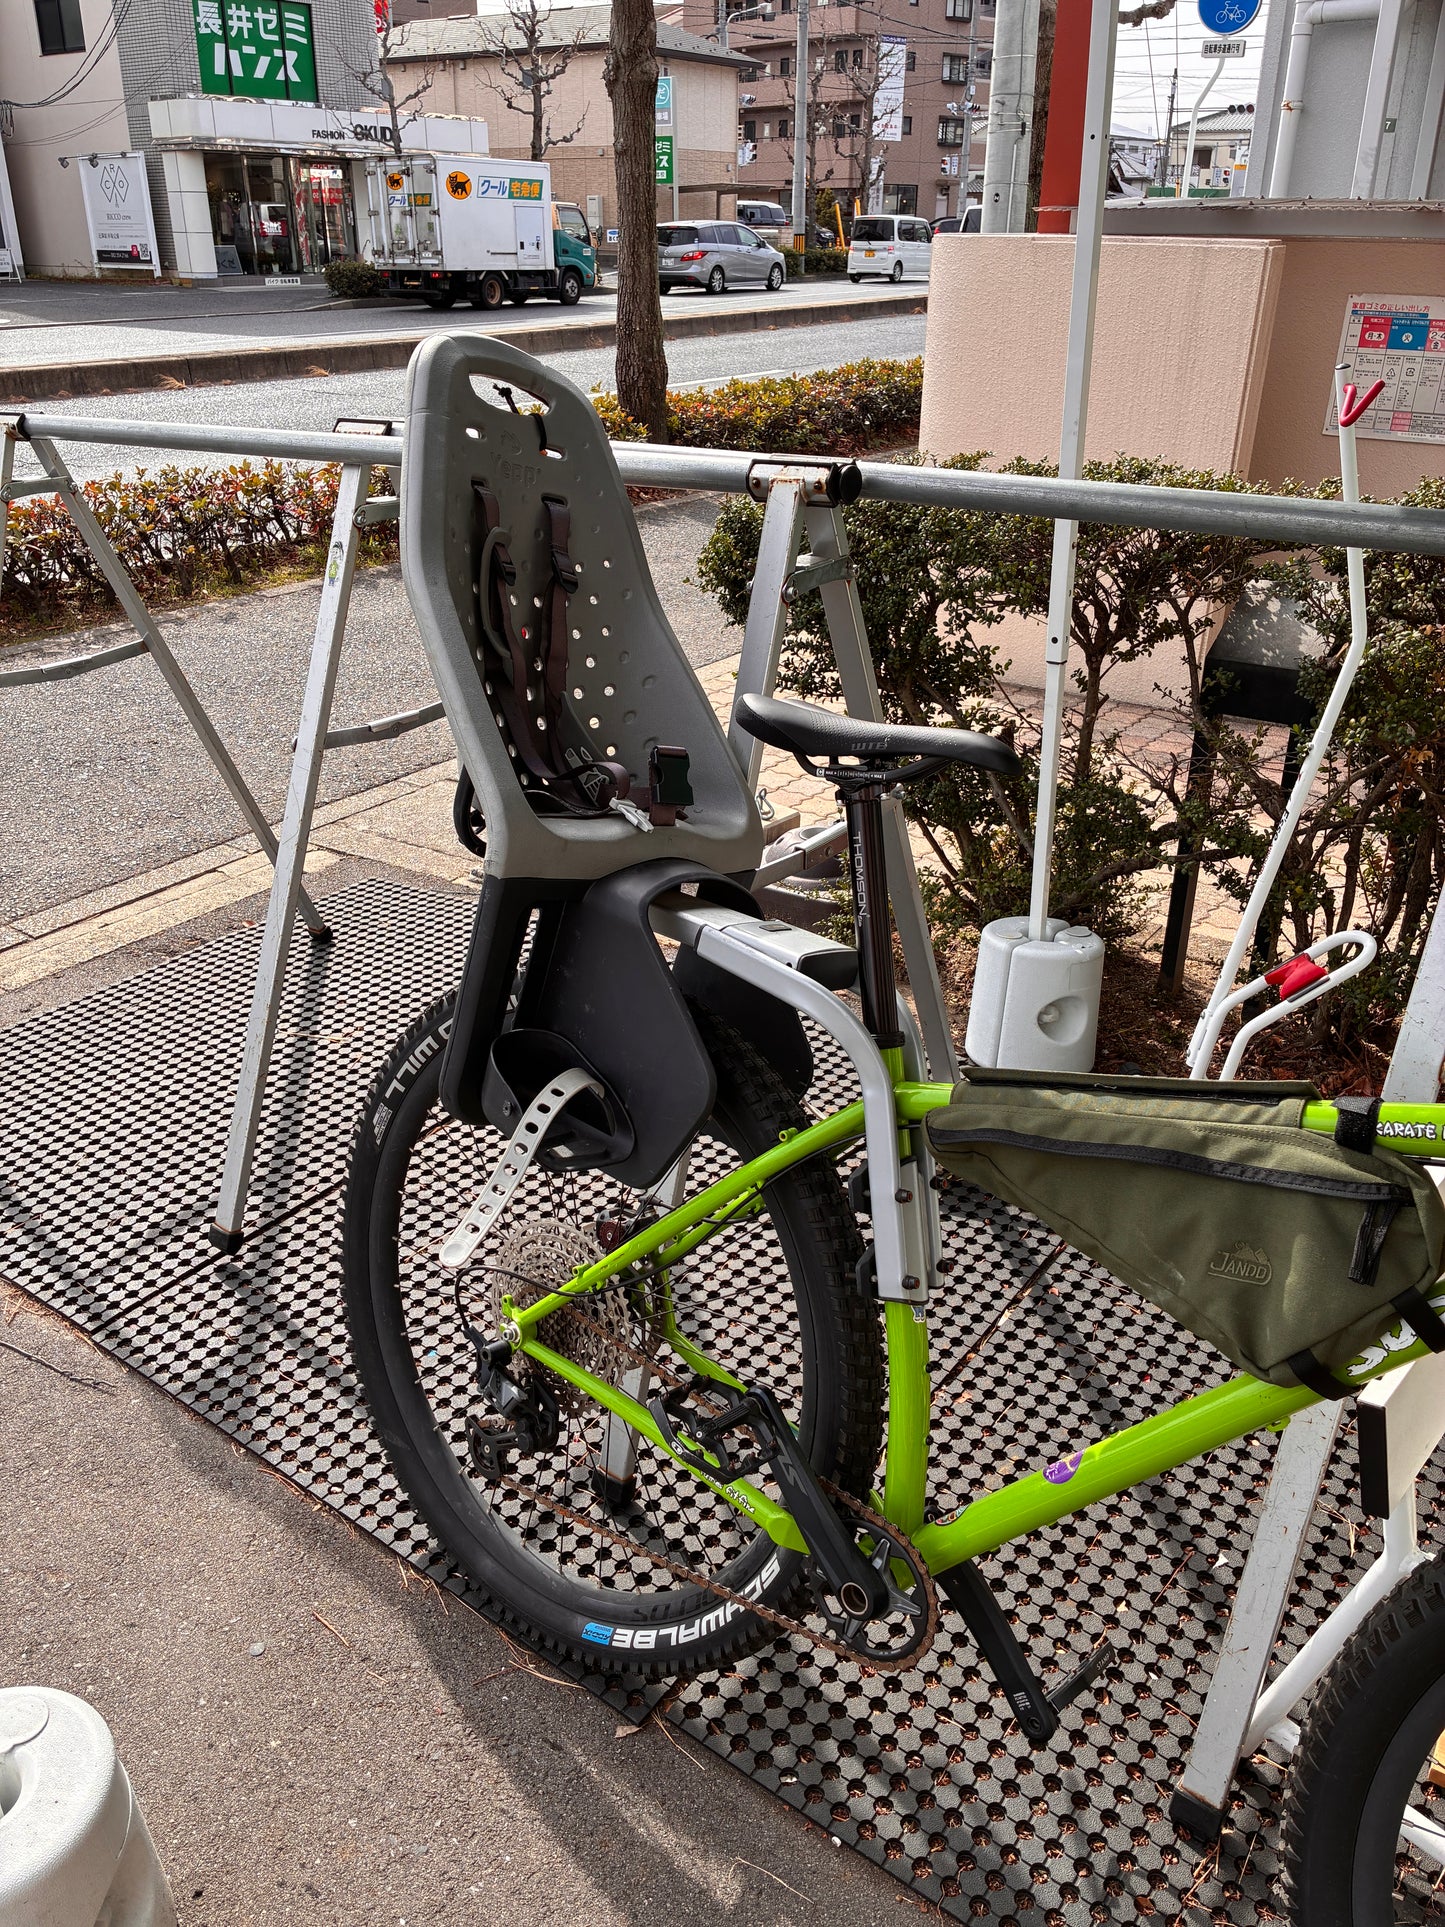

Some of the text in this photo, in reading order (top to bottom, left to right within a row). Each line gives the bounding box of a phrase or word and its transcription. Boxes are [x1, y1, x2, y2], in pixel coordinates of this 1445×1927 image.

[197, 1, 308, 44] 長井ゼミ
[214, 42, 302, 82] ハンス
[312, 123, 402, 143] FASHION OKUD
[1385, 121, 1391, 130] 7
[1352, 302, 1430, 312] 家庭ゴミの正しい出し方
[852, 831, 868, 918] THOMSON
[385, 1035, 440, 1099] WILL
[1210, 1251, 1267, 1280] JANDD
[611, 1552, 781, 1650] SCHWALBE
